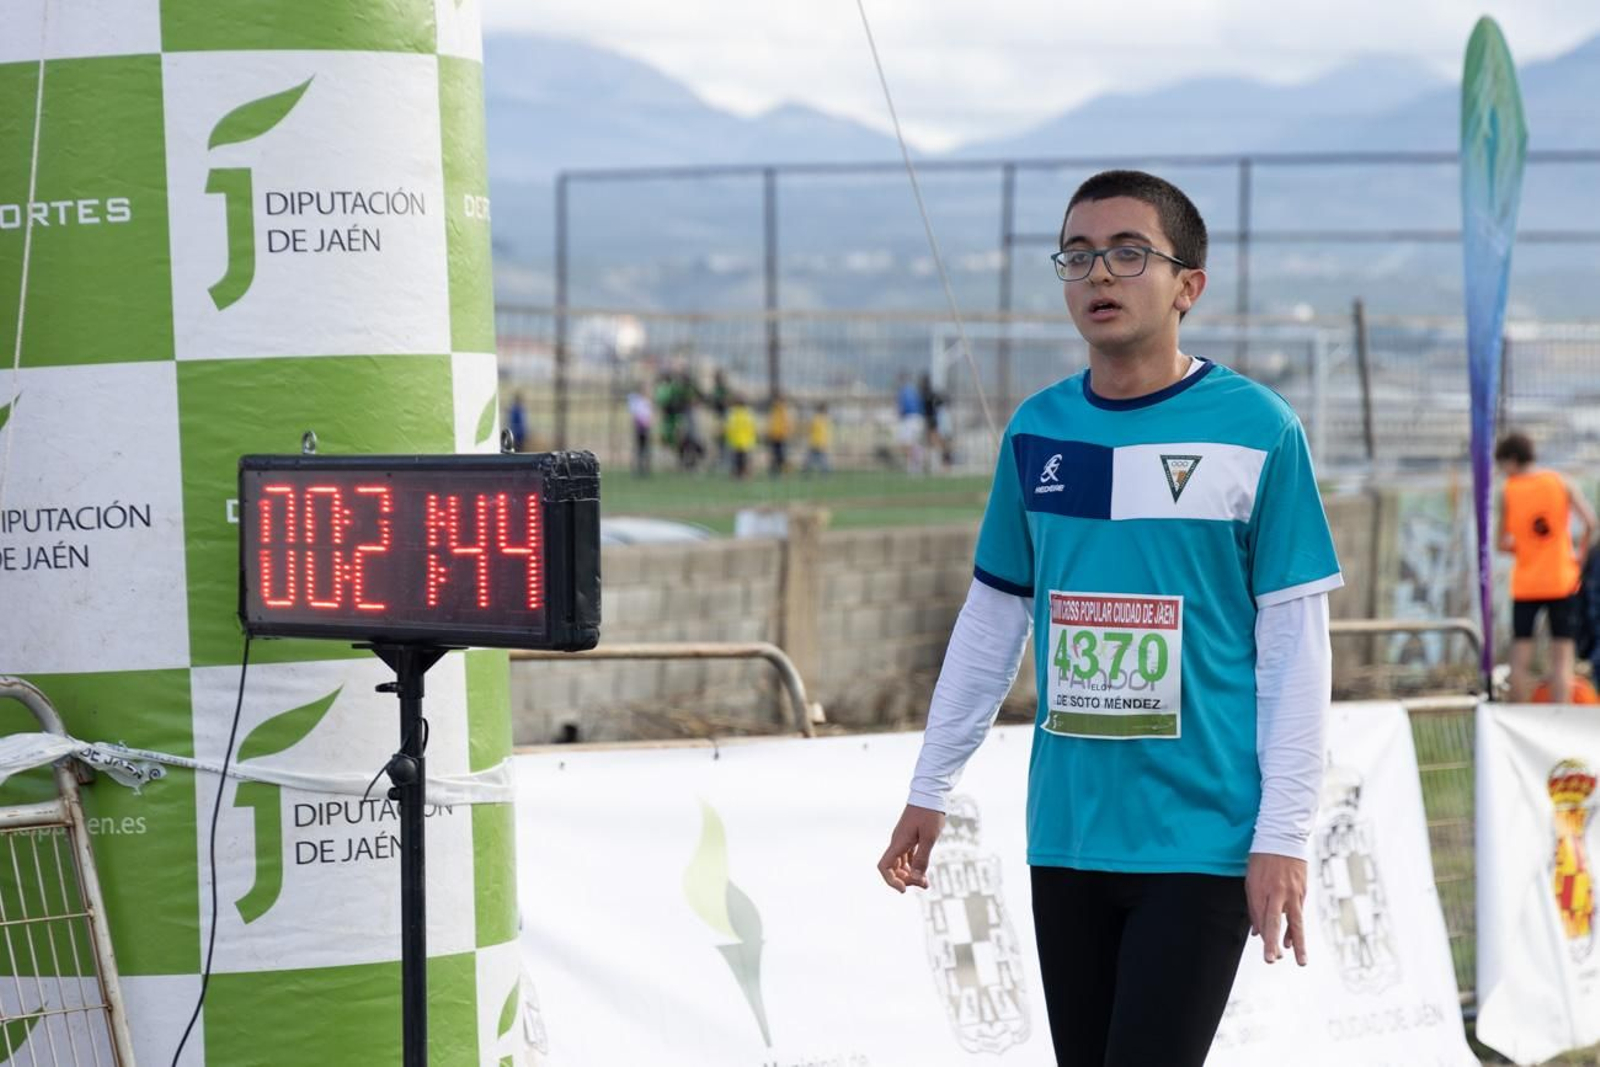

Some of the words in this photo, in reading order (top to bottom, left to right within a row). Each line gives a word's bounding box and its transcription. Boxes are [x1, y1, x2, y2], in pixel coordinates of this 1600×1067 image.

[266, 187, 425, 215] DIPUTACIÓN
[268, 229, 308, 253] DE
[313, 224, 381, 252] JAÉN
[0, 547, 17, 571] E
[21, 541, 89, 570] JAÉN
[1080, 601, 1112, 622] POPULAR
[1113, 602, 1141, 624] CIUDAD
[1142, 603, 1154, 625] DE
[1054, 629, 1168, 682] 4370
[1091, 683, 1113, 692] ELOY
[1056, 694, 1068, 706] DE
[1070, 695, 1100, 709] SOTO
[1104, 694, 1161, 710] MÉNDEZ
[295, 840, 336, 865] DE
